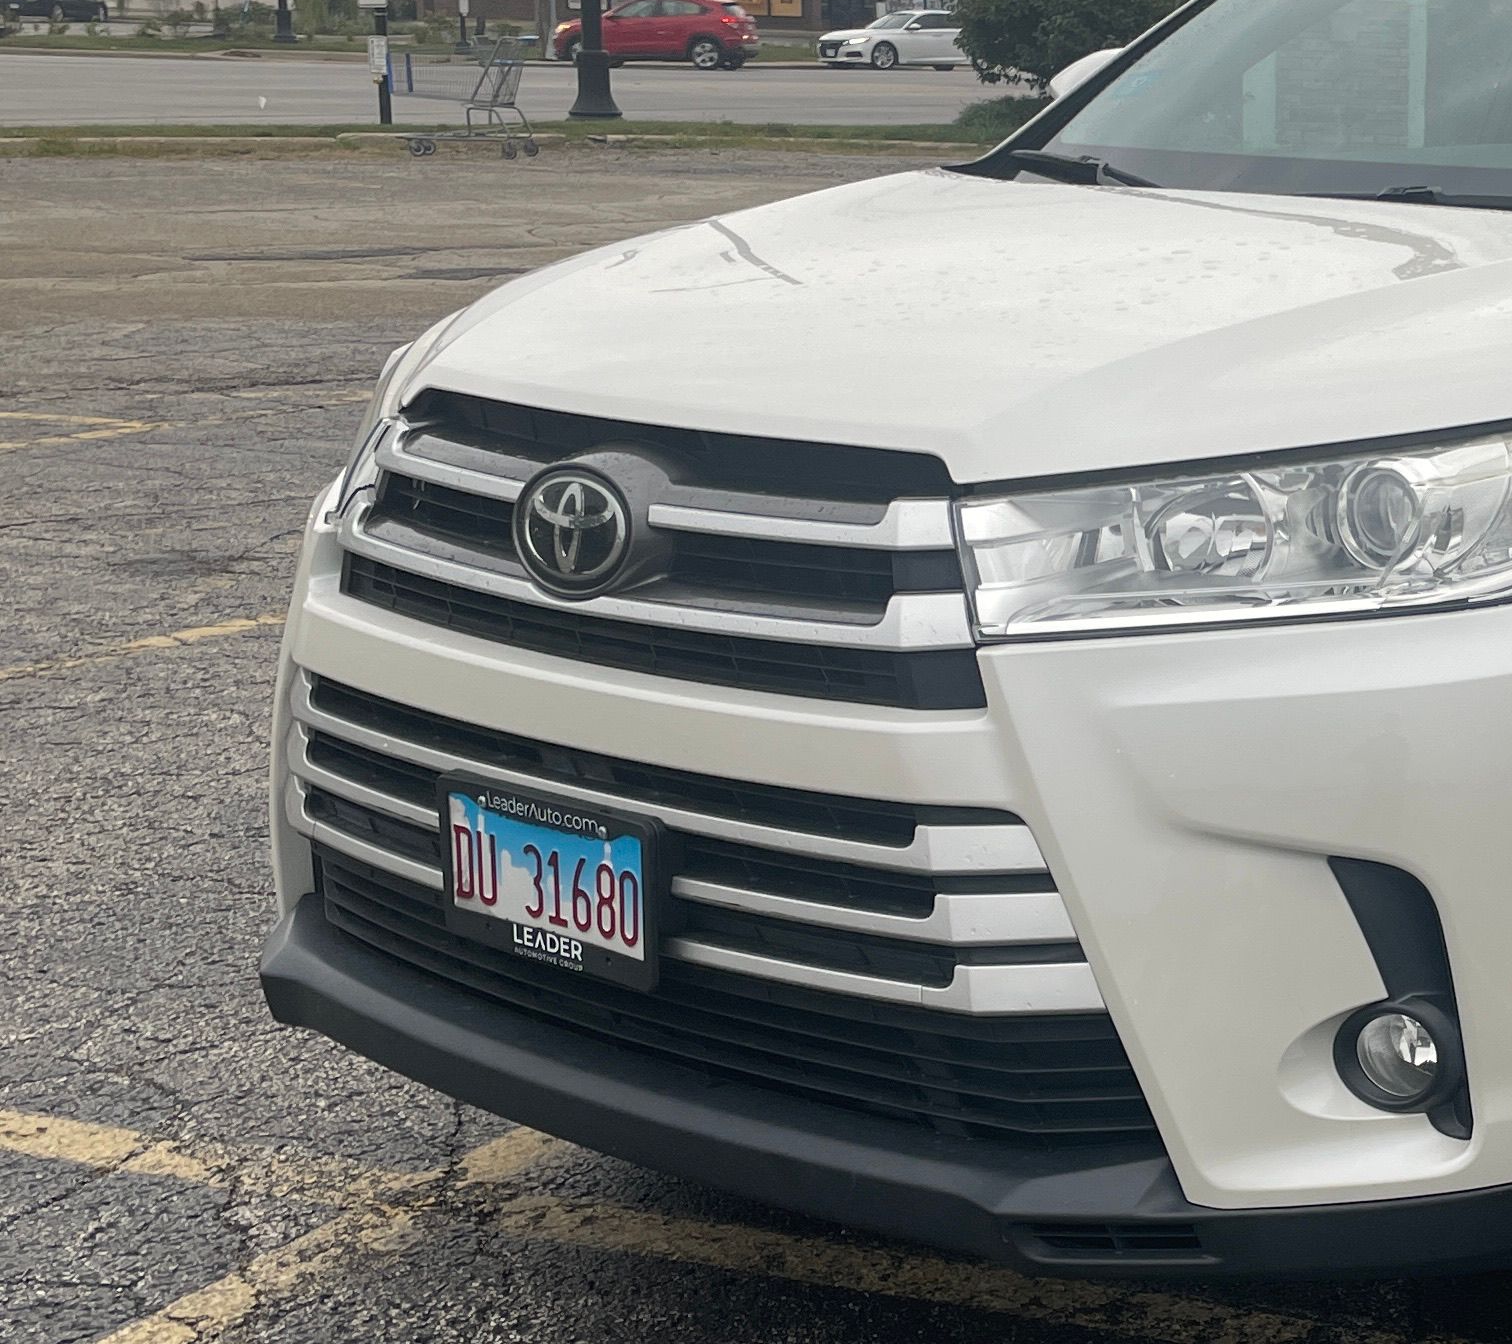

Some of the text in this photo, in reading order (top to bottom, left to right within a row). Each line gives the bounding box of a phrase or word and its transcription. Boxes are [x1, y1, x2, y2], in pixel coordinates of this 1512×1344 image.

[485, 790, 600, 833] LeaderAuto.com
[453, 824, 639, 948] DU 31680
[512, 923, 583, 962] LEADER
[514, 946, 584, 972] AUTOMOTIVE GROUP
